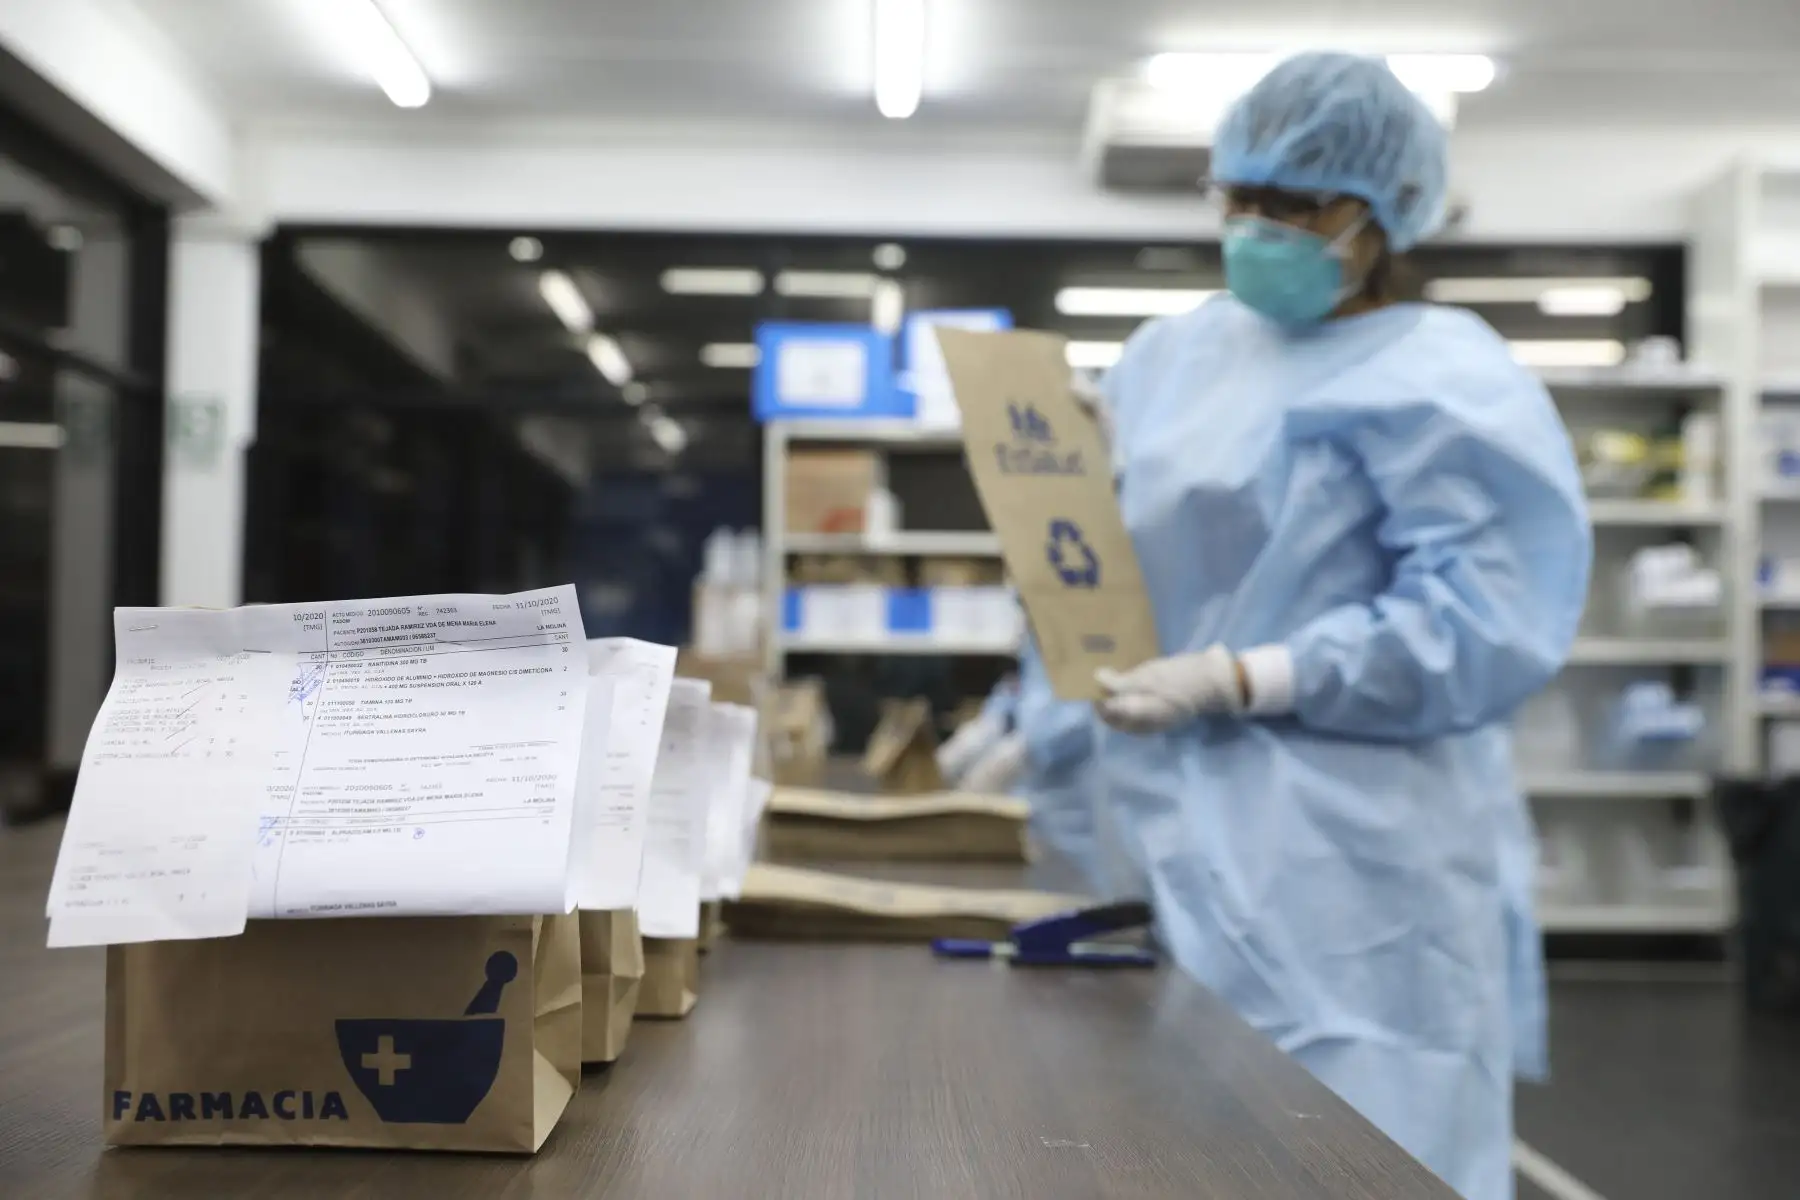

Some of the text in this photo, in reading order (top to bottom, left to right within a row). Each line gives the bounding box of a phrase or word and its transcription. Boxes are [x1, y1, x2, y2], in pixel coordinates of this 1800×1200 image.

[515, 597, 559, 610] 31/10/2020
[378, 625, 400, 633] TEJADA
[400, 623, 425, 631] RAMIREZ
[546, 622, 567, 630] MOLINA
[518, 667, 553, 675] DIMETICONA
[112, 1090, 349, 1122] FARMACIA
